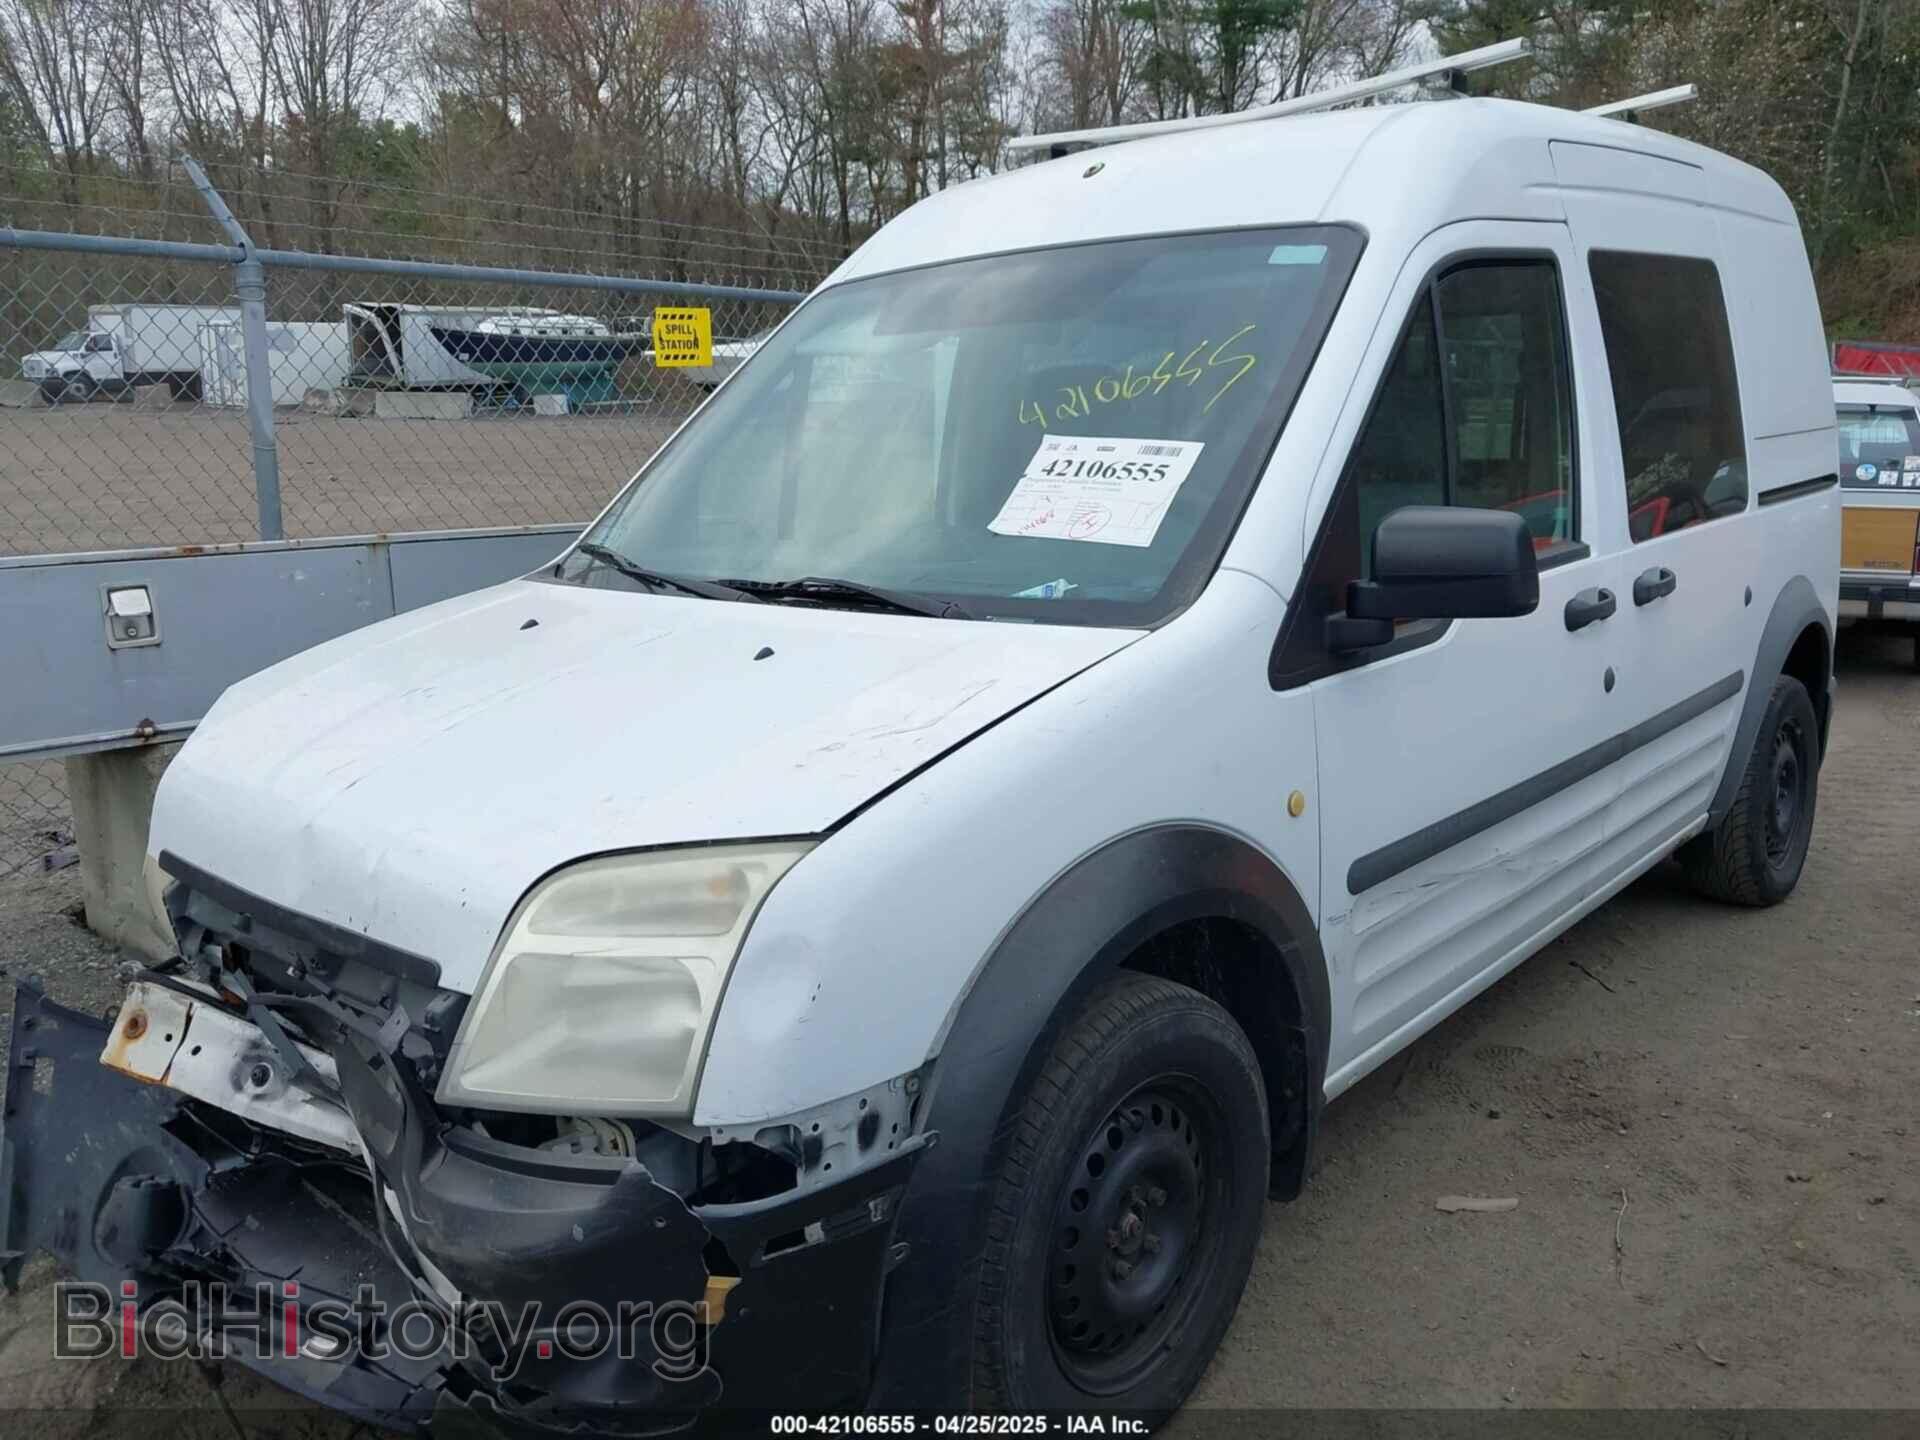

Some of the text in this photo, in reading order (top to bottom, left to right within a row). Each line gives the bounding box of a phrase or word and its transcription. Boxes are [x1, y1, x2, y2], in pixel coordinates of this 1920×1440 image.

[665, 323, 693, 335] SPILL
[659, 339, 699, 350] STATION
[1017, 324, 1256, 429] 42106555
[1041, 458, 1172, 483] 42106555
